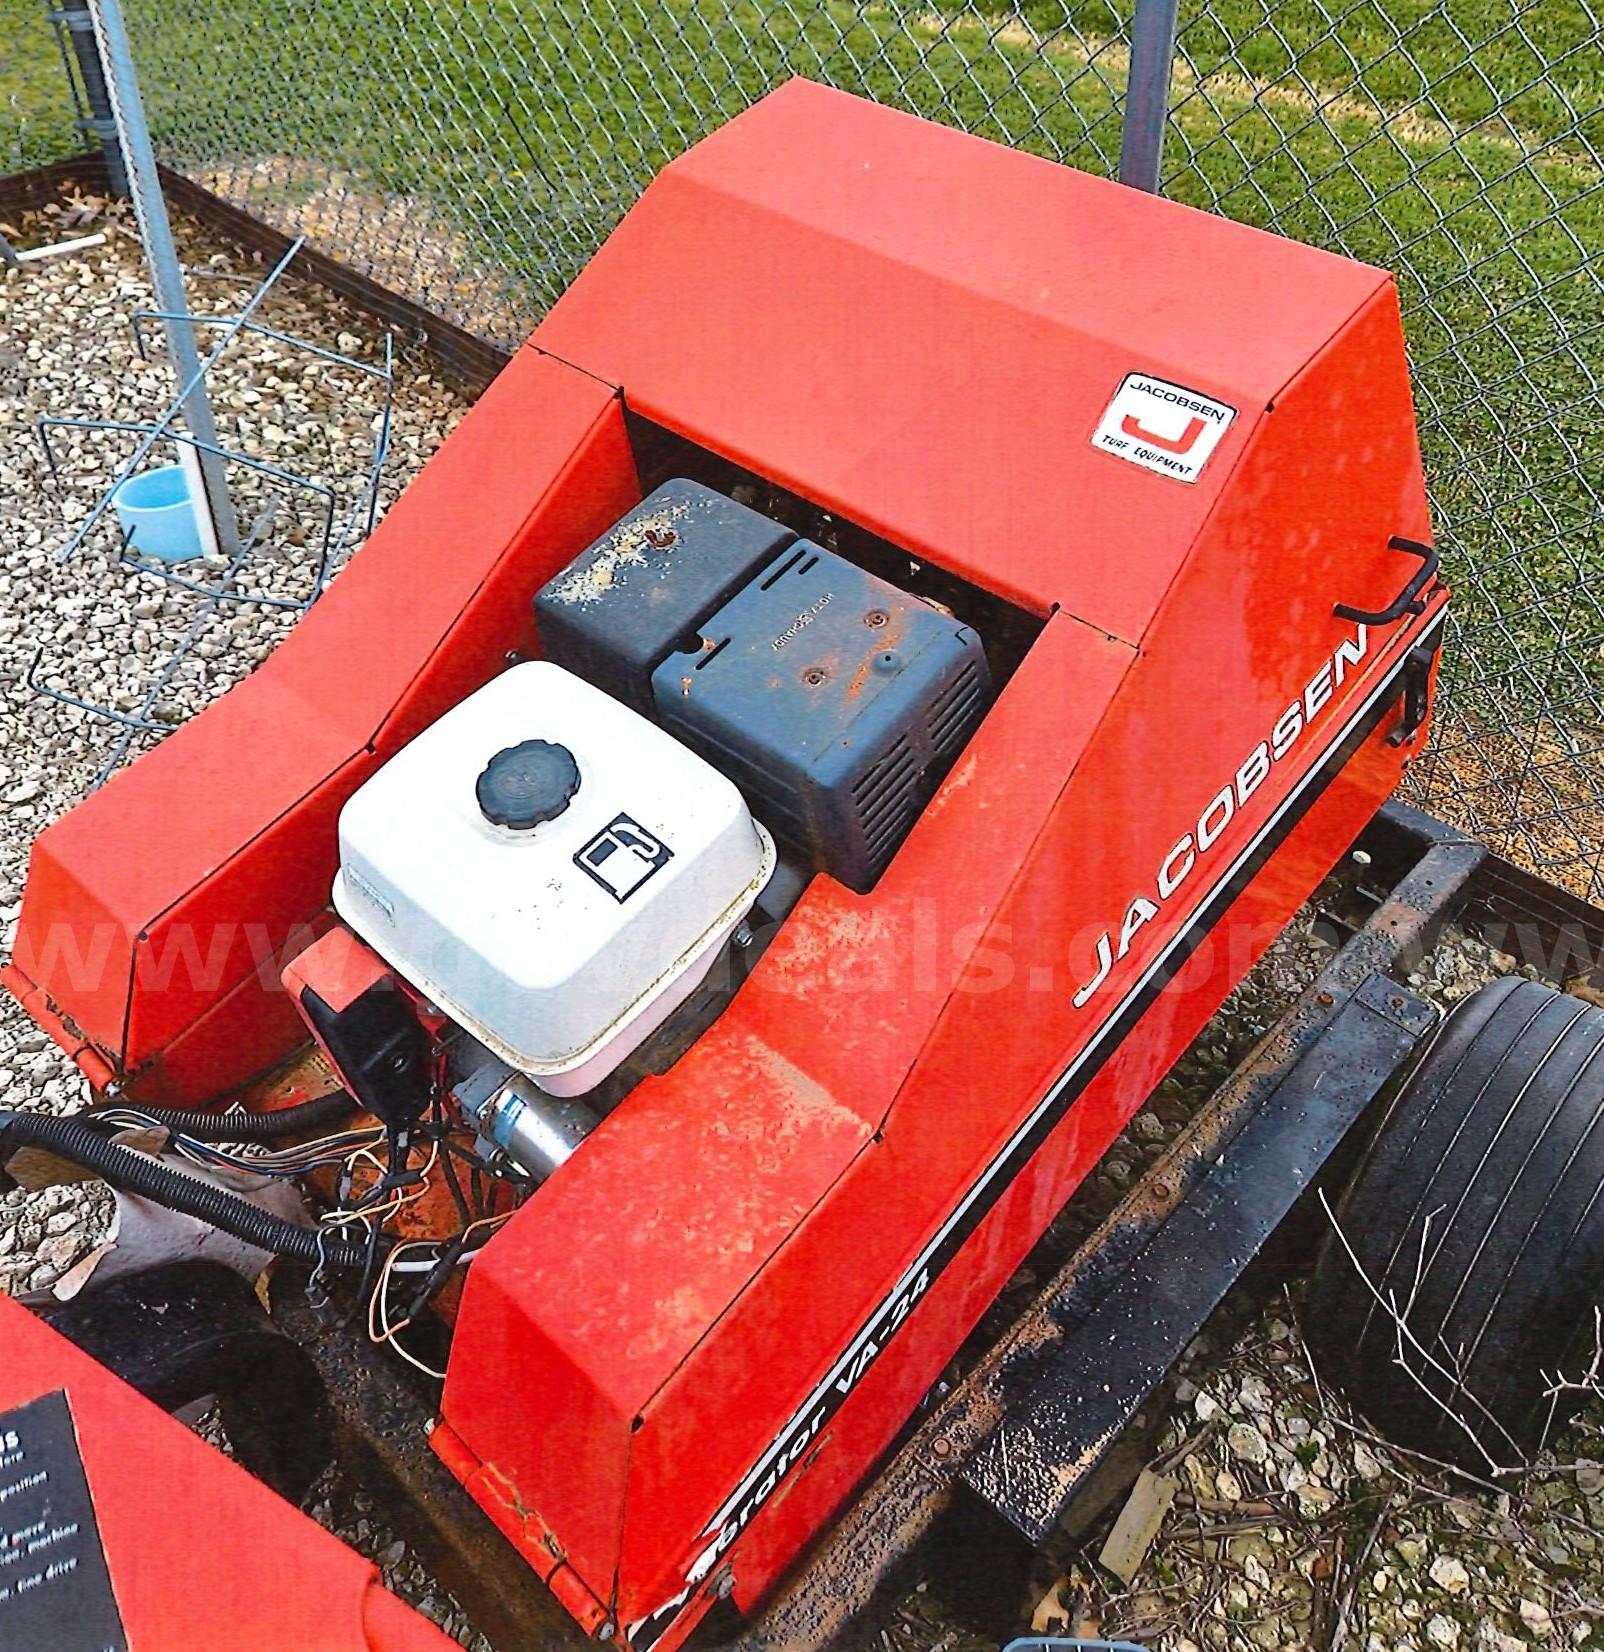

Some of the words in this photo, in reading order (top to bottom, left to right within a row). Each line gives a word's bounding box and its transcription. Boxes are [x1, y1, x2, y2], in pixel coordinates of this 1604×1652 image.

[1130, 381, 1226, 421] JACOBSEN
[1102, 434, 1130, 450] TURF
[1133, 446, 1193, 475] EQUIPMENT
[1071, 622, 1368, 1010] JACOBSEN
[835, 1267, 930, 1394] VA-24
